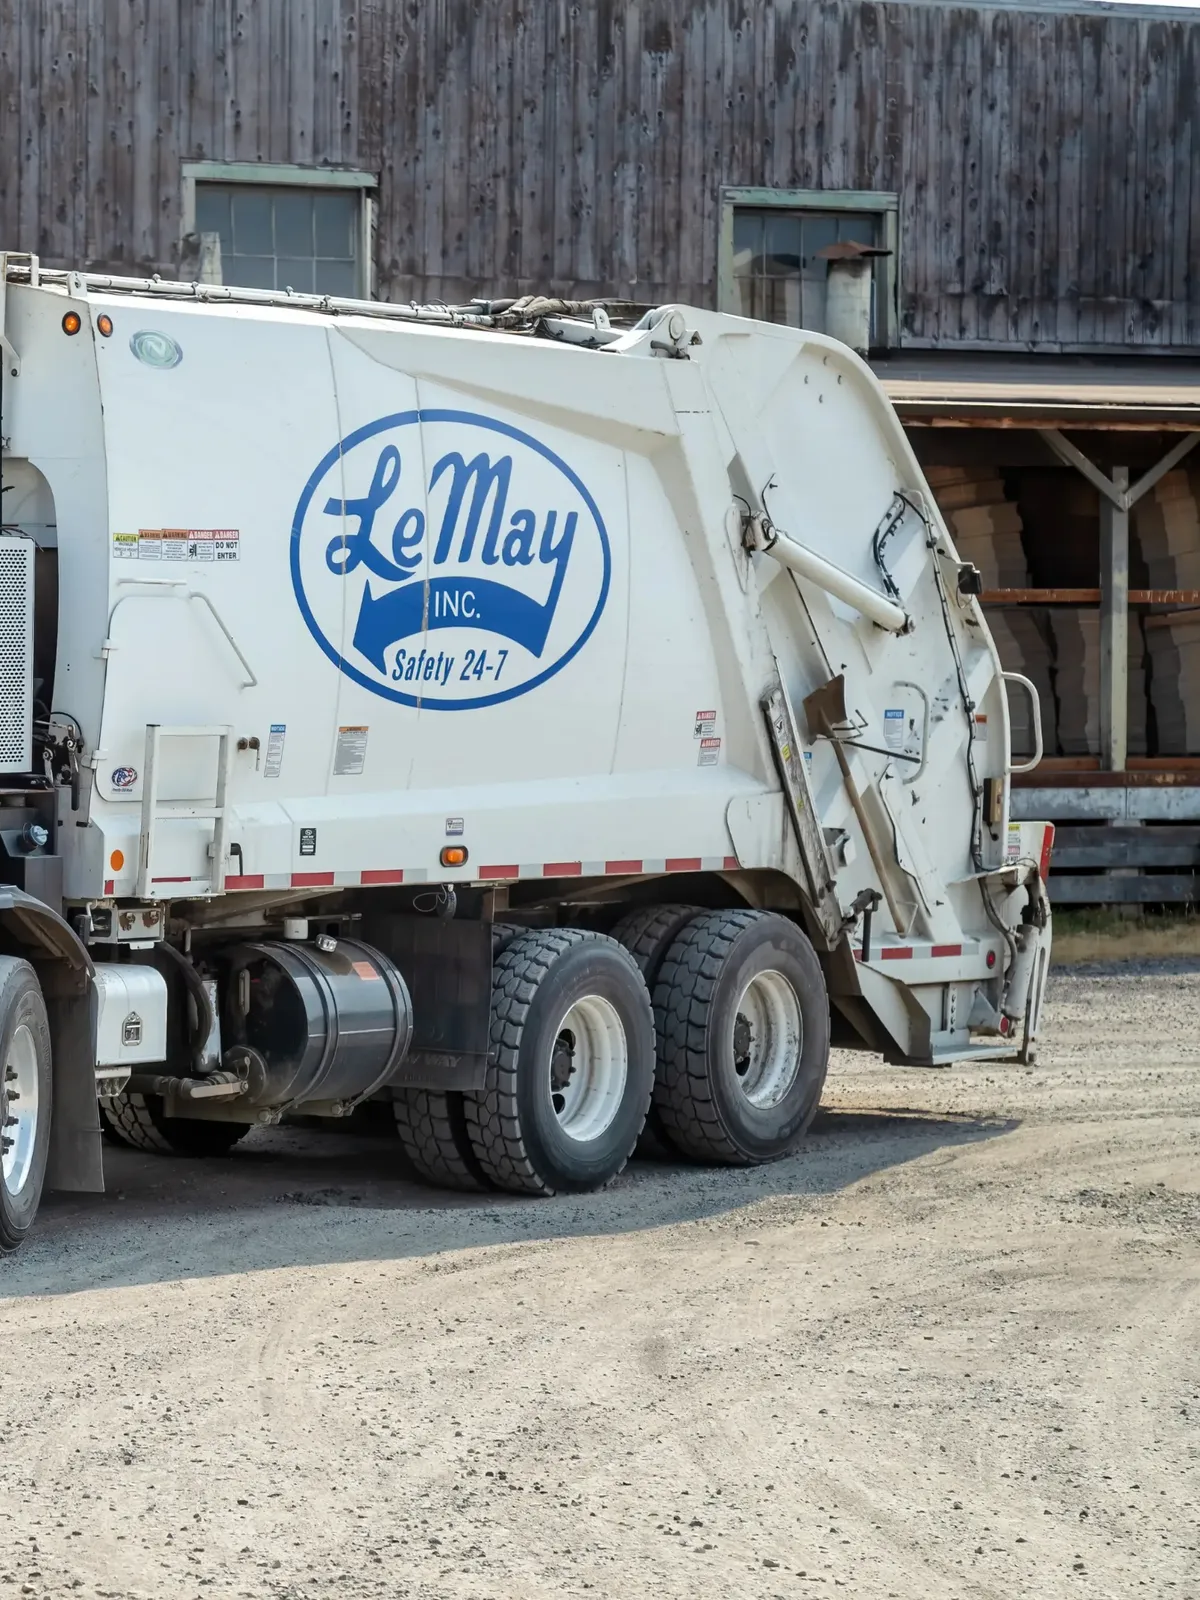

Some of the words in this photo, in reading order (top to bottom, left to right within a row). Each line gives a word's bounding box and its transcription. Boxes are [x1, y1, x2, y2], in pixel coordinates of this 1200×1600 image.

[194, 530, 213, 538] DANGER
[220, 530, 238, 538] DANGER
[215, 541, 224, 549] DO
[226, 541, 237, 549] NOT
[434, 590, 481, 618] INC.
[392, 649, 455, 686] Safety
[459, 650, 509, 681] 24-7
